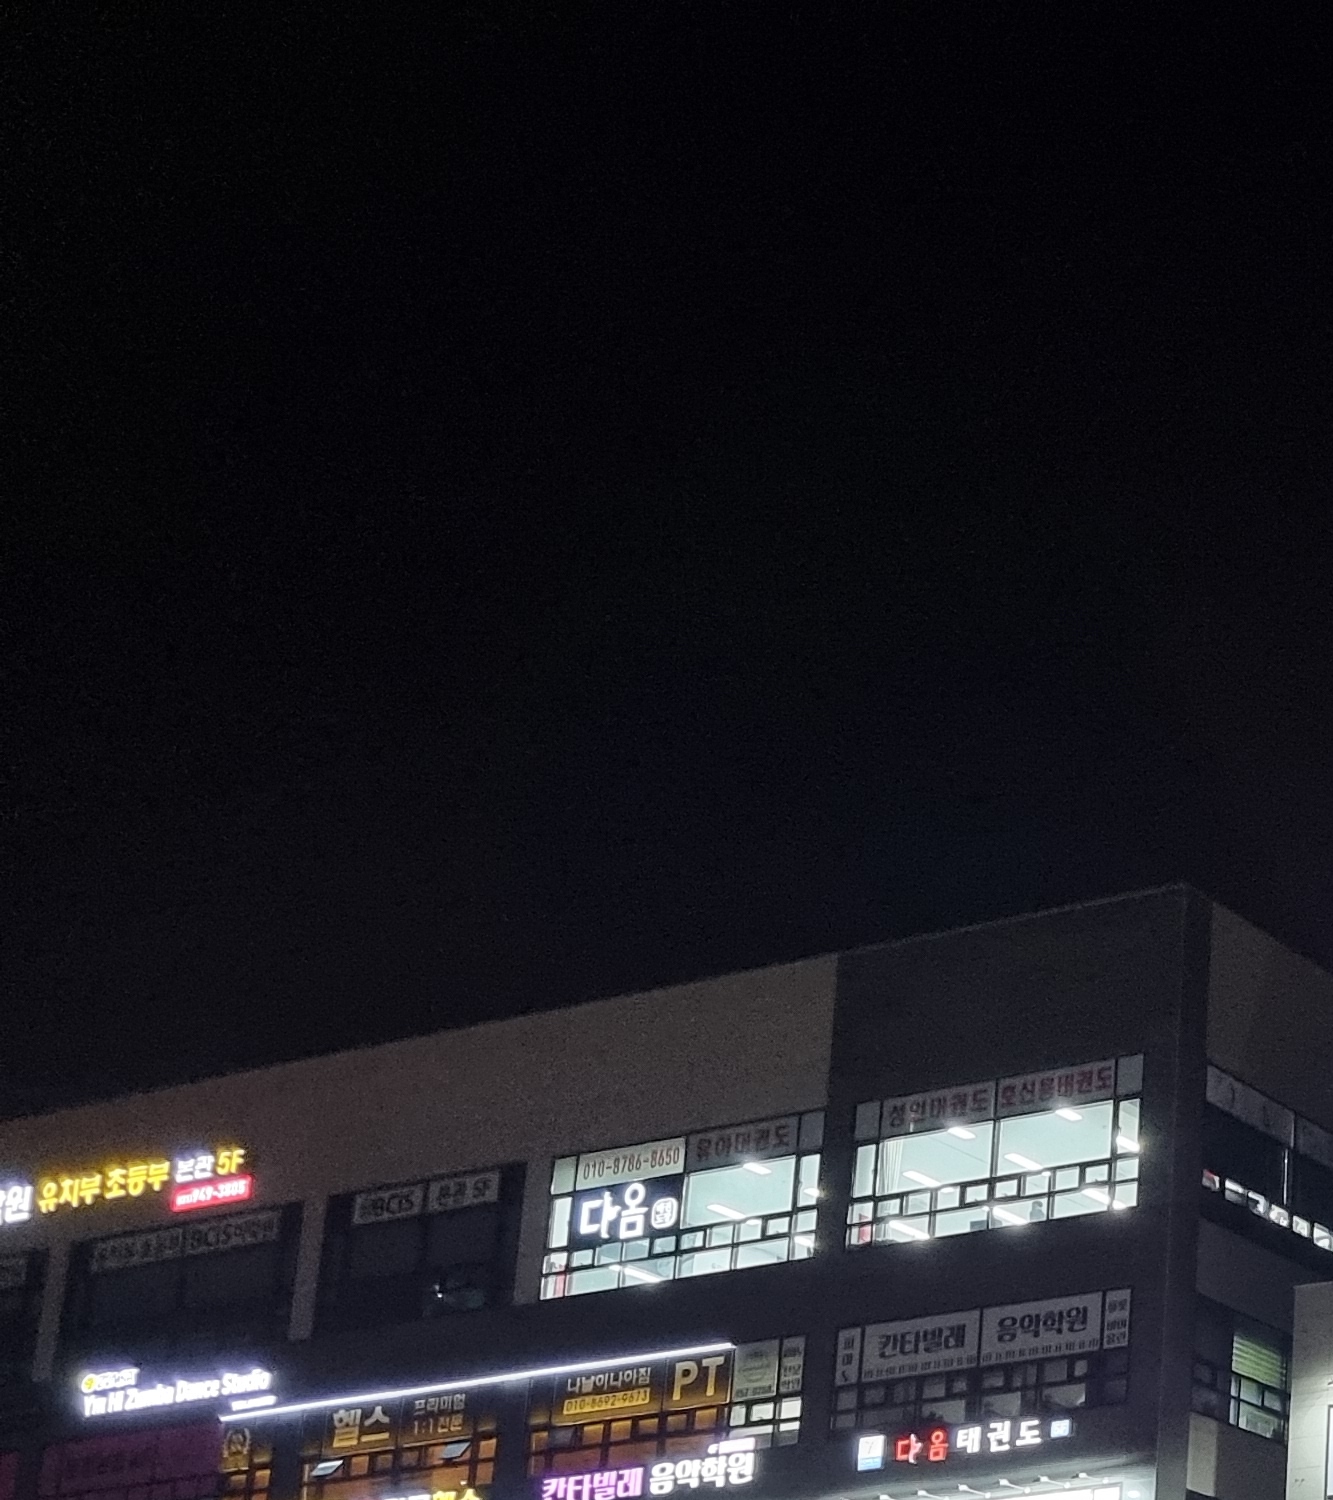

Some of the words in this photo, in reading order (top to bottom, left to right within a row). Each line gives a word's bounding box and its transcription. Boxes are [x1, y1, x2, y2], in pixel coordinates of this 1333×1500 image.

[583, 1146, 680, 1181] 010-8786-8650
[0, 1185, 34, 1227] 원
[38, 1174, 103, 1214] 유치부
[104, 1160, 170, 1200] 초등부
[215, 1149, 246, 1176] 5F
[878, 1322, 966, 1358] 칸타빌레
[998, 1305, 1088, 1342] 음악학원
[672, 1356, 725, 1400] PT
[332, 1405, 389, 1448] 헬스
[956, 1419, 1043, 1453] 태권도
[649, 1452, 755, 1496] 음악학원
